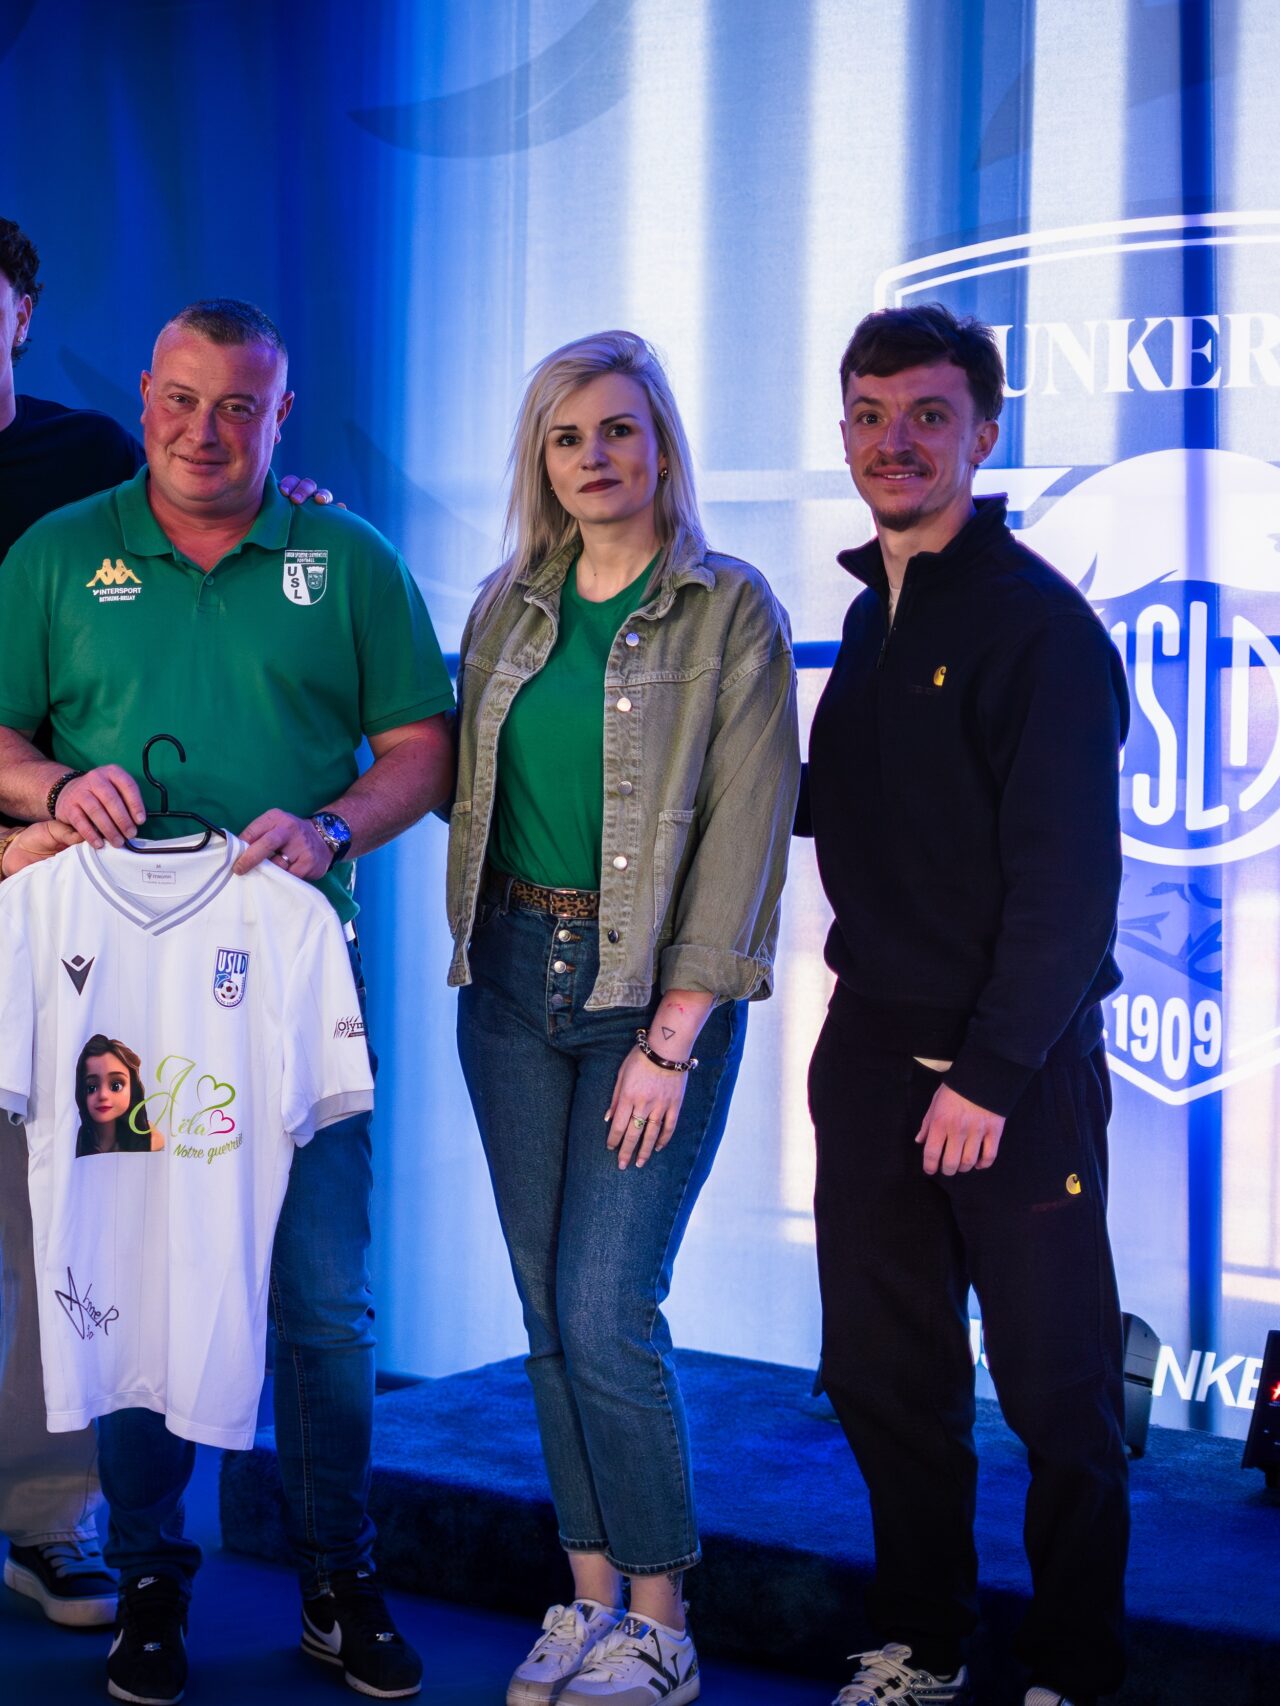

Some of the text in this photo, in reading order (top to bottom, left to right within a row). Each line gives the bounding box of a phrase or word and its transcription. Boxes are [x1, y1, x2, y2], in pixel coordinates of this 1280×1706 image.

[990, 313, 1280, 398] UNKER
[99, 587, 142, 596] INTERSPORT
[1110, 600, 1280, 831] SLD
[217, 951, 247, 975] USLD
[1111, 993, 1222, 1081] 1909
[173, 1143, 205, 1159] Notre
